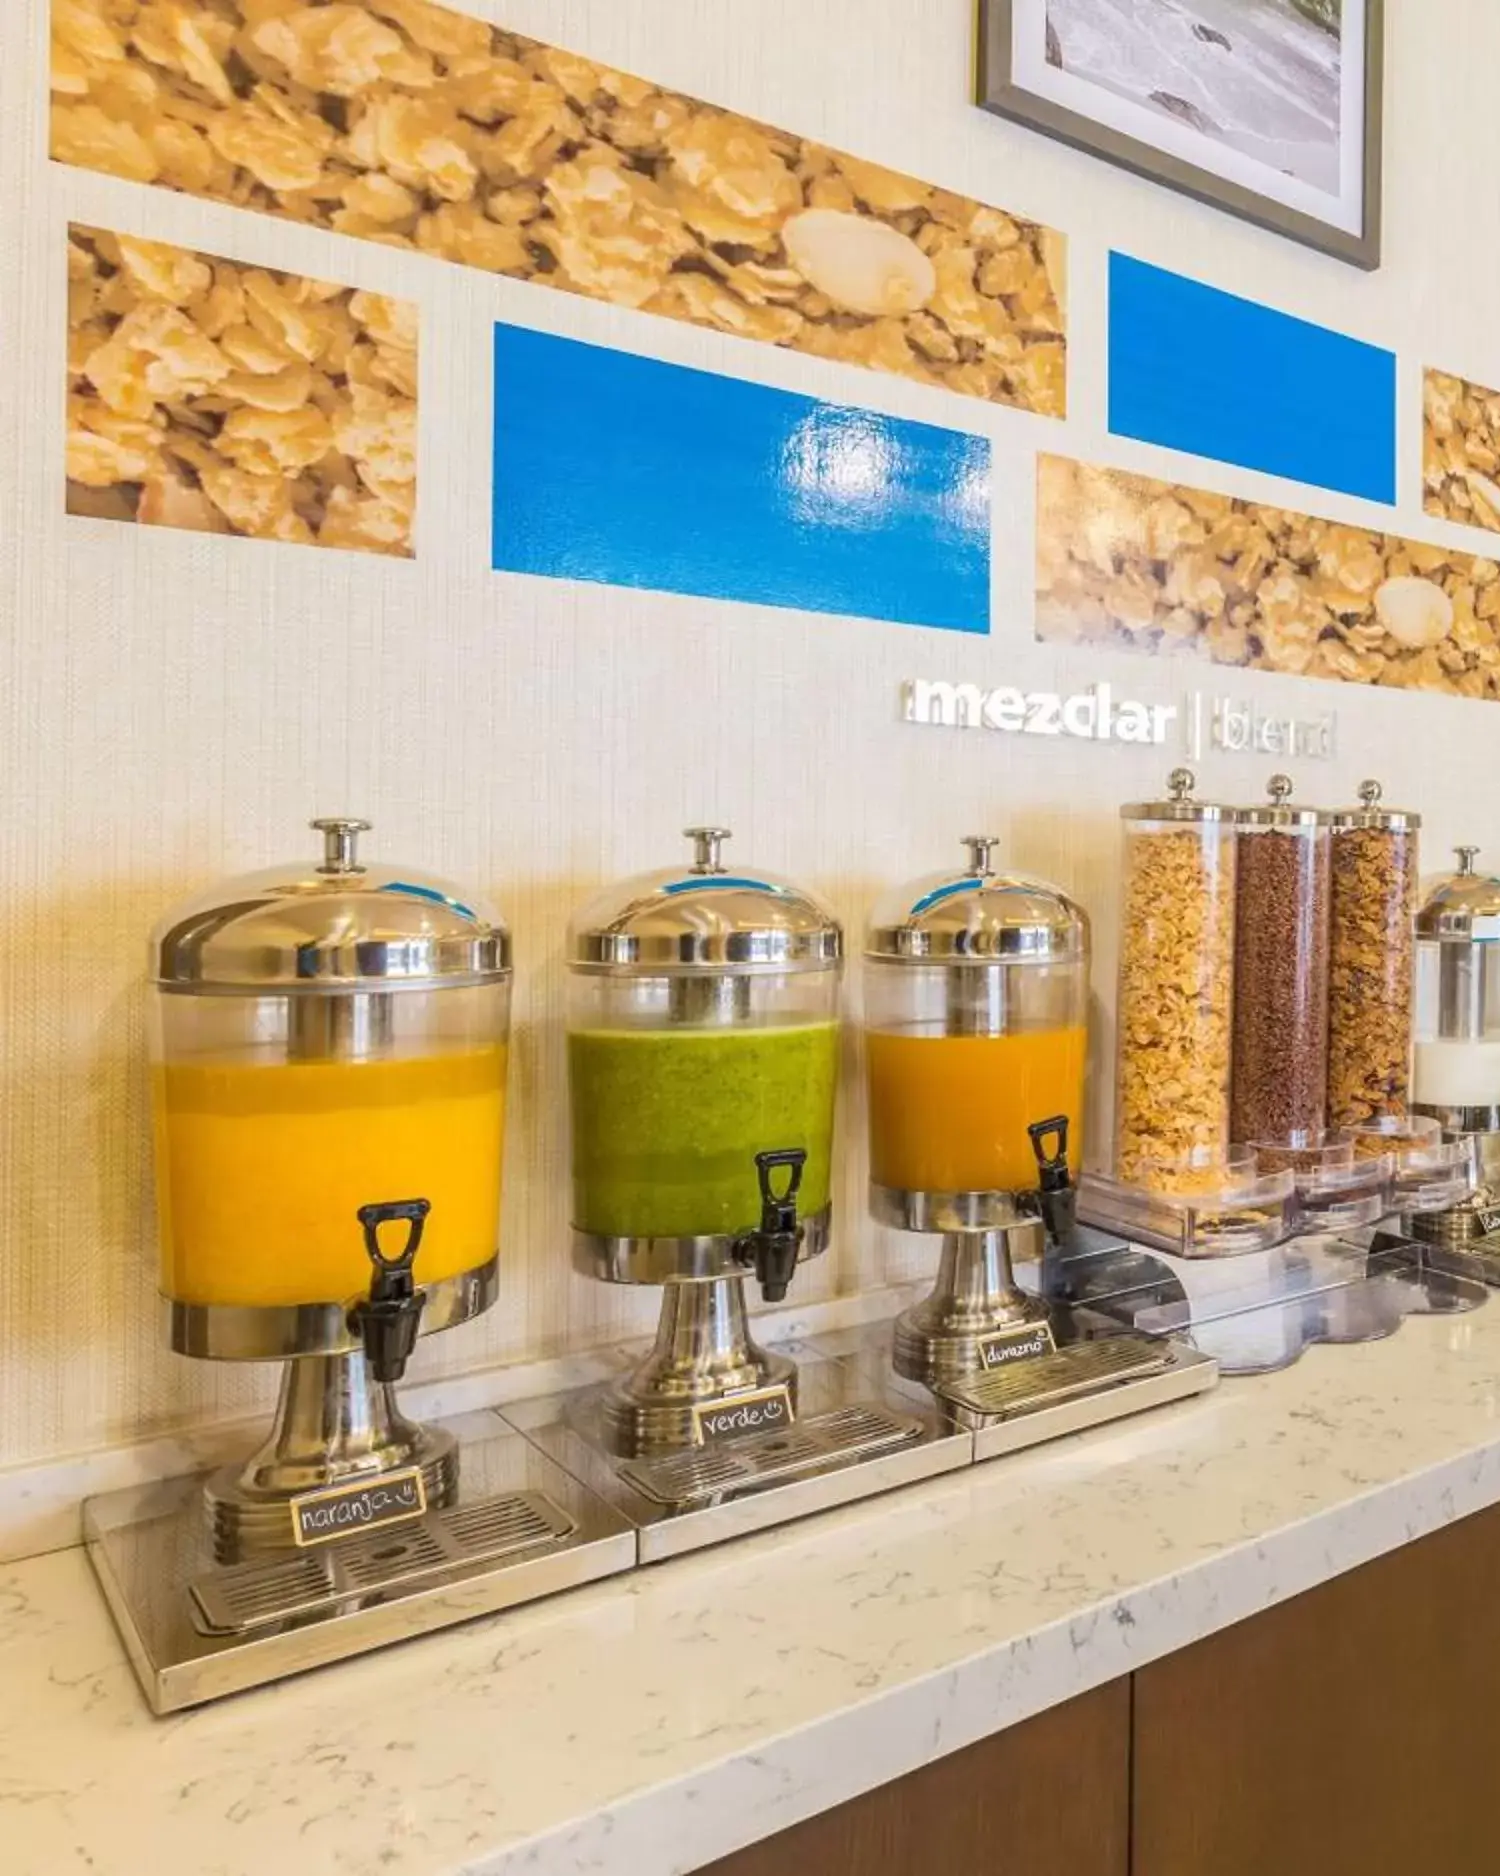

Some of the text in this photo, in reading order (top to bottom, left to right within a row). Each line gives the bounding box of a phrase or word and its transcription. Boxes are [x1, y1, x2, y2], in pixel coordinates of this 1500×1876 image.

[902, 678, 1176, 743] mezclar
[705, 1407, 763, 1435] verde
[301, 1491, 392, 1530] naranja
